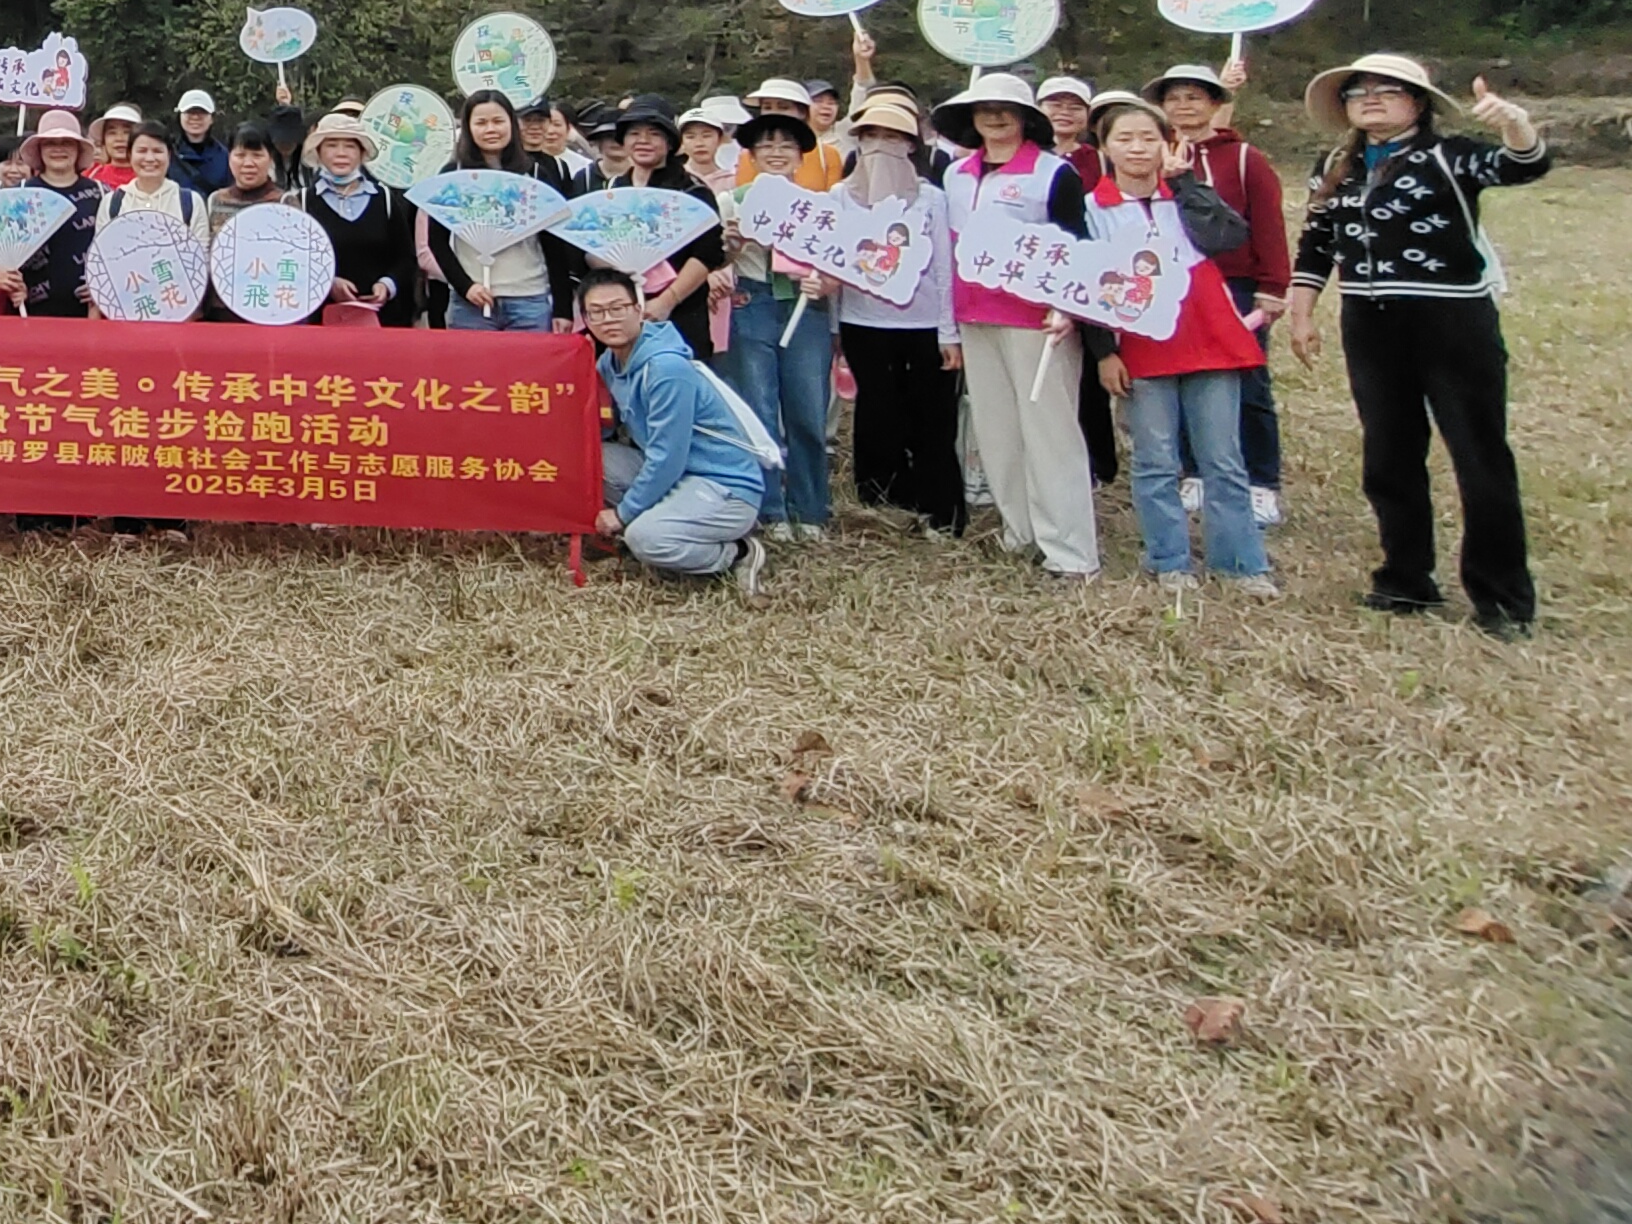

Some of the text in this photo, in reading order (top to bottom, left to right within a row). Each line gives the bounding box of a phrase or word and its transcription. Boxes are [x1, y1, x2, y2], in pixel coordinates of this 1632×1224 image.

[1394, 176, 1434, 200] OK
[790, 199, 837, 231] 传承
[1371, 198, 1412, 221] OK
[1410, 213, 1451, 235] OK
[753, 210, 846, 268] 中华文化
[1014, 234, 1070, 267] 传承
[244, 257, 299, 282] 小雪
[1403, 248, 1447, 272] OK
[125, 258, 173, 294] 小雪
[973, 250, 1090, 306] 中华文化
[165, 473, 377, 502] 2025年3月5日
